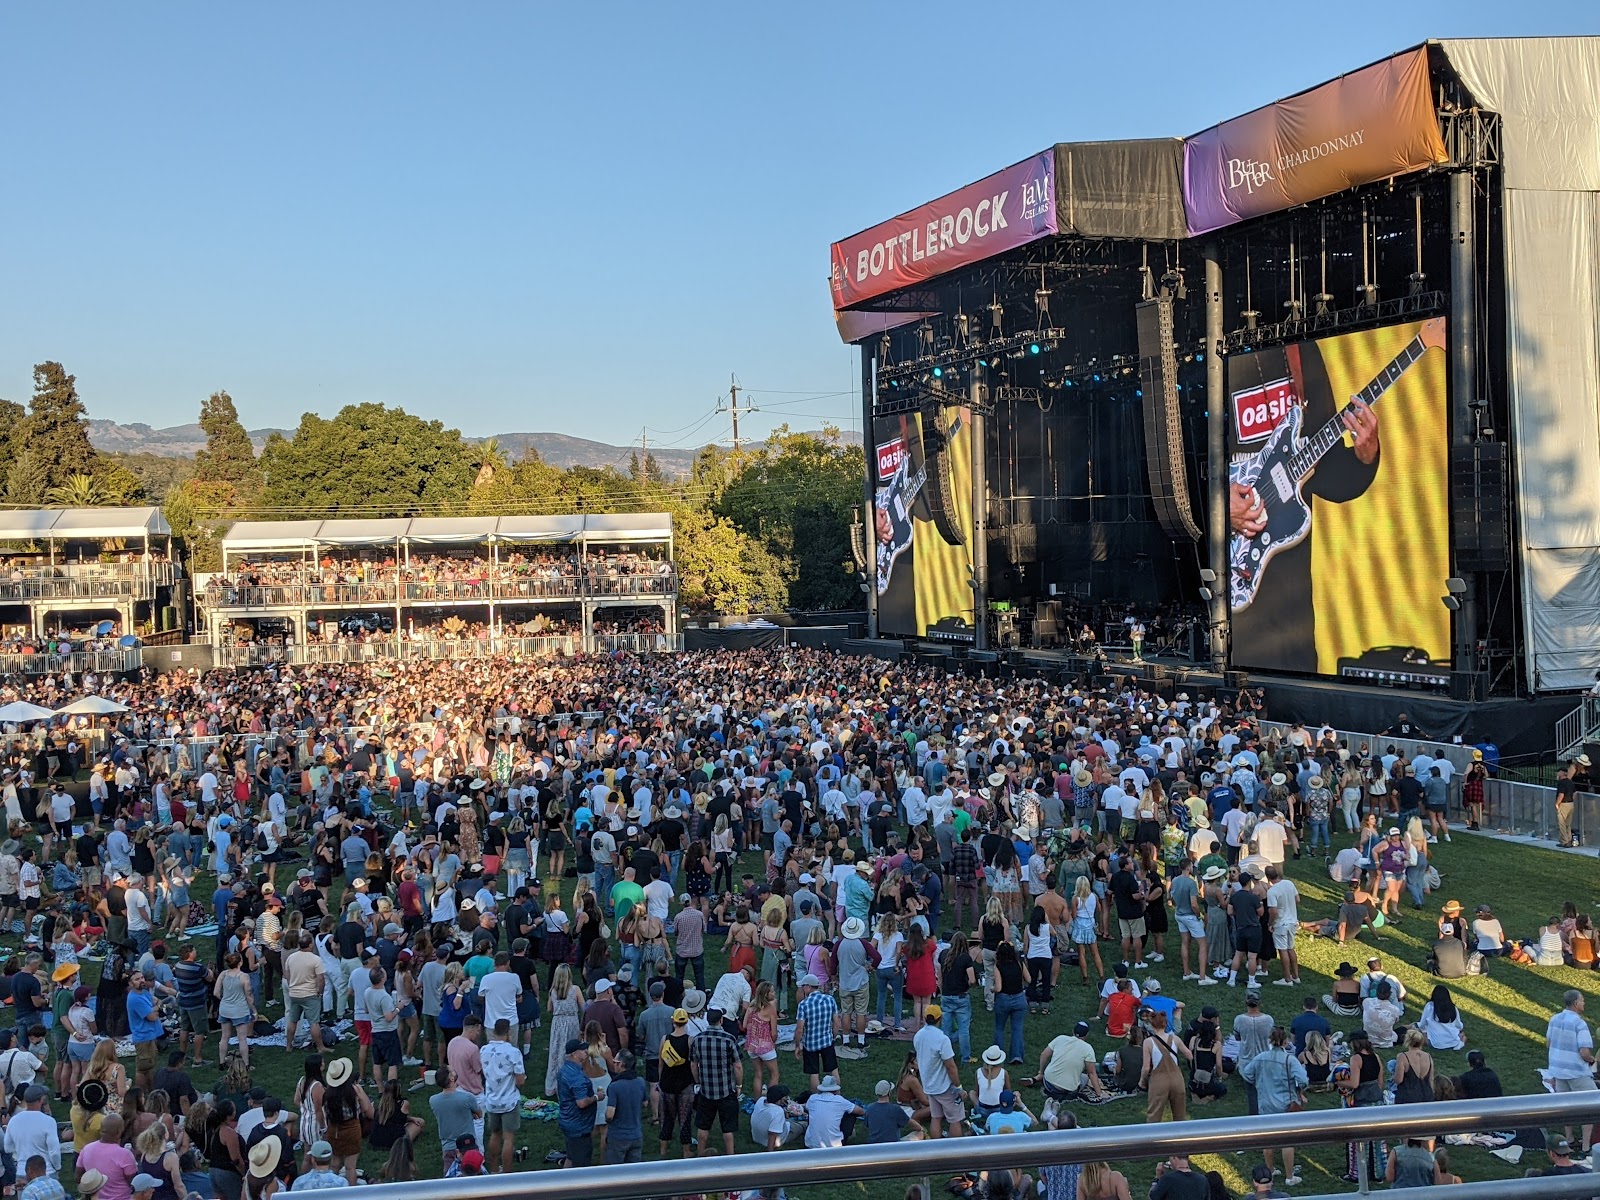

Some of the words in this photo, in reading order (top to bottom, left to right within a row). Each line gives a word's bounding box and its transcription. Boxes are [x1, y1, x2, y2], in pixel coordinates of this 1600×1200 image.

[1277, 129, 1364, 171] CHARDONNAY
[1024, 202, 1049, 220] CELLARS
[856, 190, 1009, 282] BOTTLEROCK
